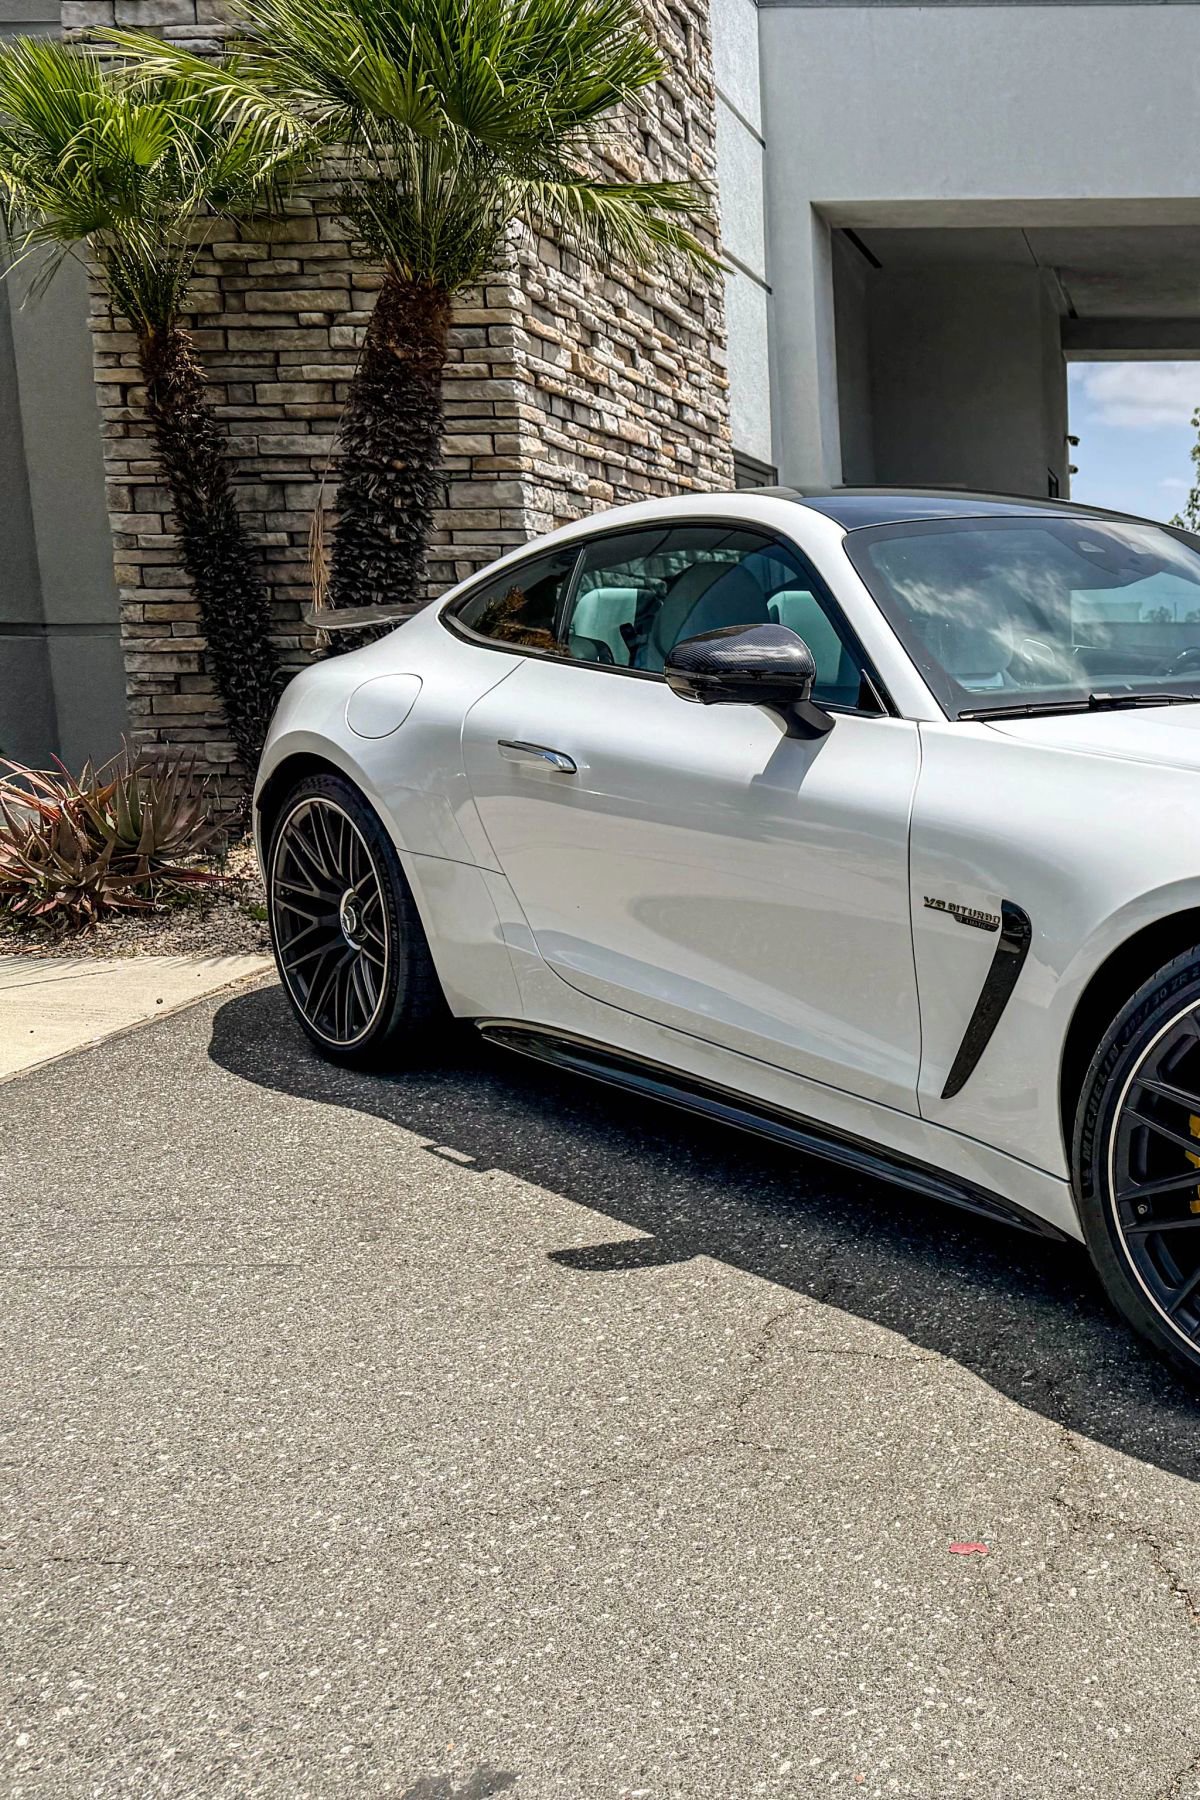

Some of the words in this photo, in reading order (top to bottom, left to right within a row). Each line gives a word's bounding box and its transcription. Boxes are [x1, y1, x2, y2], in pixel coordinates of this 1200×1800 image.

[923, 896, 945, 909] V8
[948, 903, 1000, 924] BITURBO
[1082, 1043, 1120, 1161] MICHELIN
